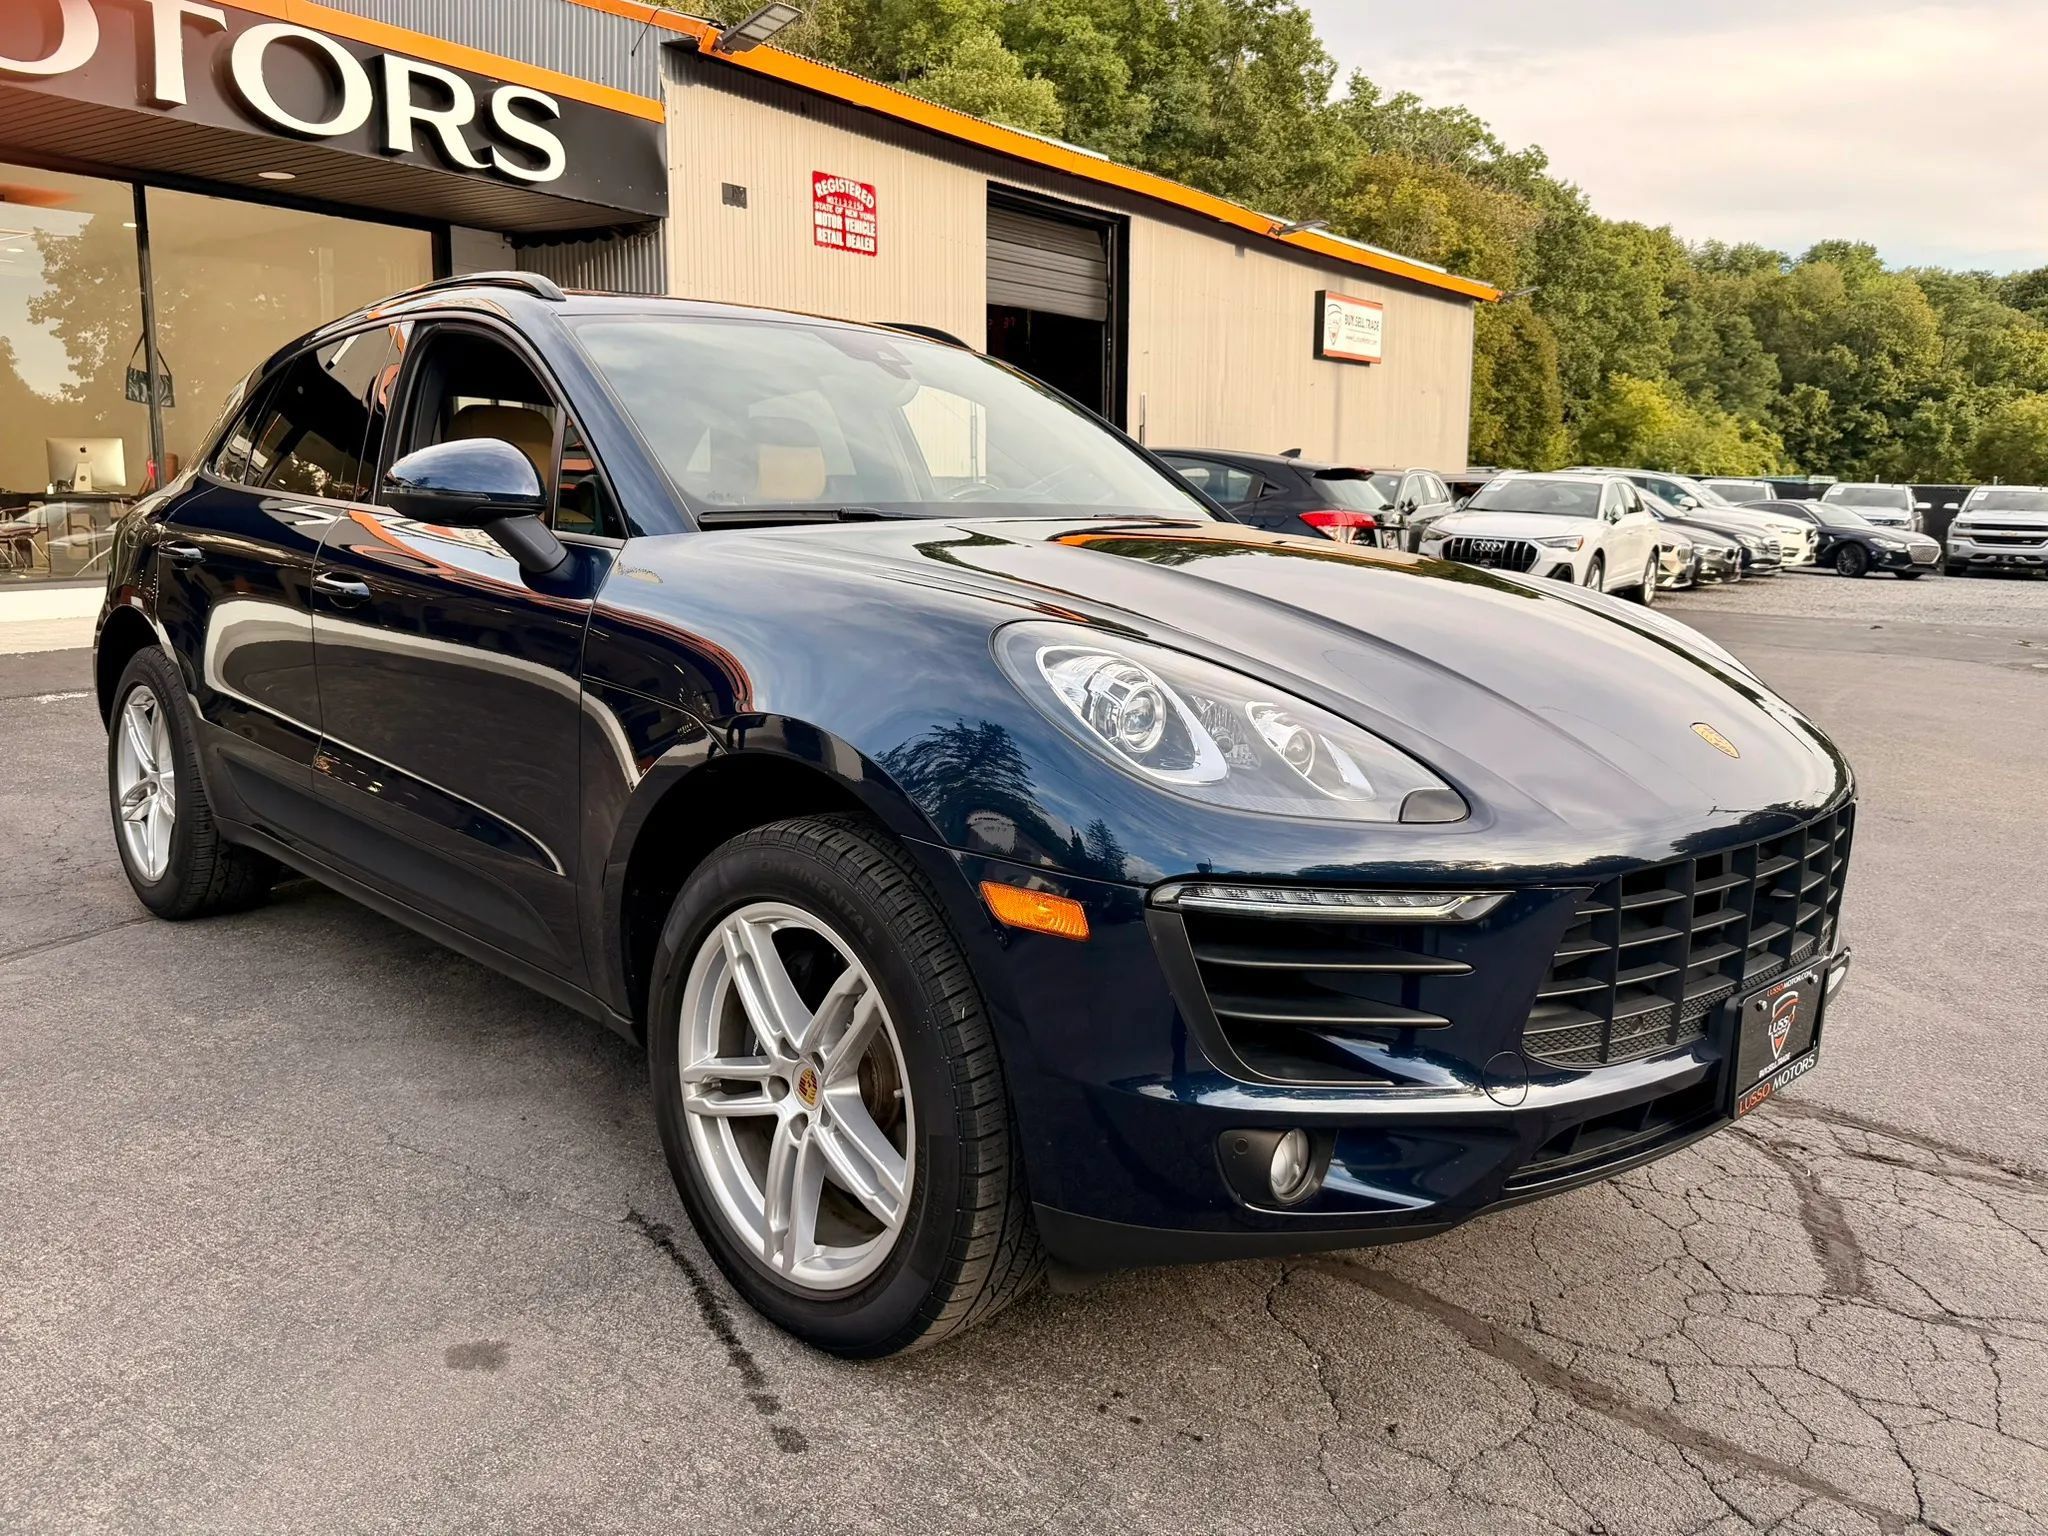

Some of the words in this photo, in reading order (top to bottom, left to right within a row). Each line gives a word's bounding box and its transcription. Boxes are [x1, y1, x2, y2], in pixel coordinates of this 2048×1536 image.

[815, 178, 875, 208] REGISTERED
[815, 201, 833, 213] STATE
[835, 206, 843, 214] OF
[845, 208, 858, 218] NEW
[859, 211, 875, 222] YORK
[815, 210, 842, 230] MOTOR
[845, 217, 875, 237] VEHICLE
[816, 227, 844, 246] RETAIL
[846, 232, 875, 252] DEALER
[1739, 1082, 1771, 1114] LUSSO
[1772, 1054, 1815, 1092] MOTORS
